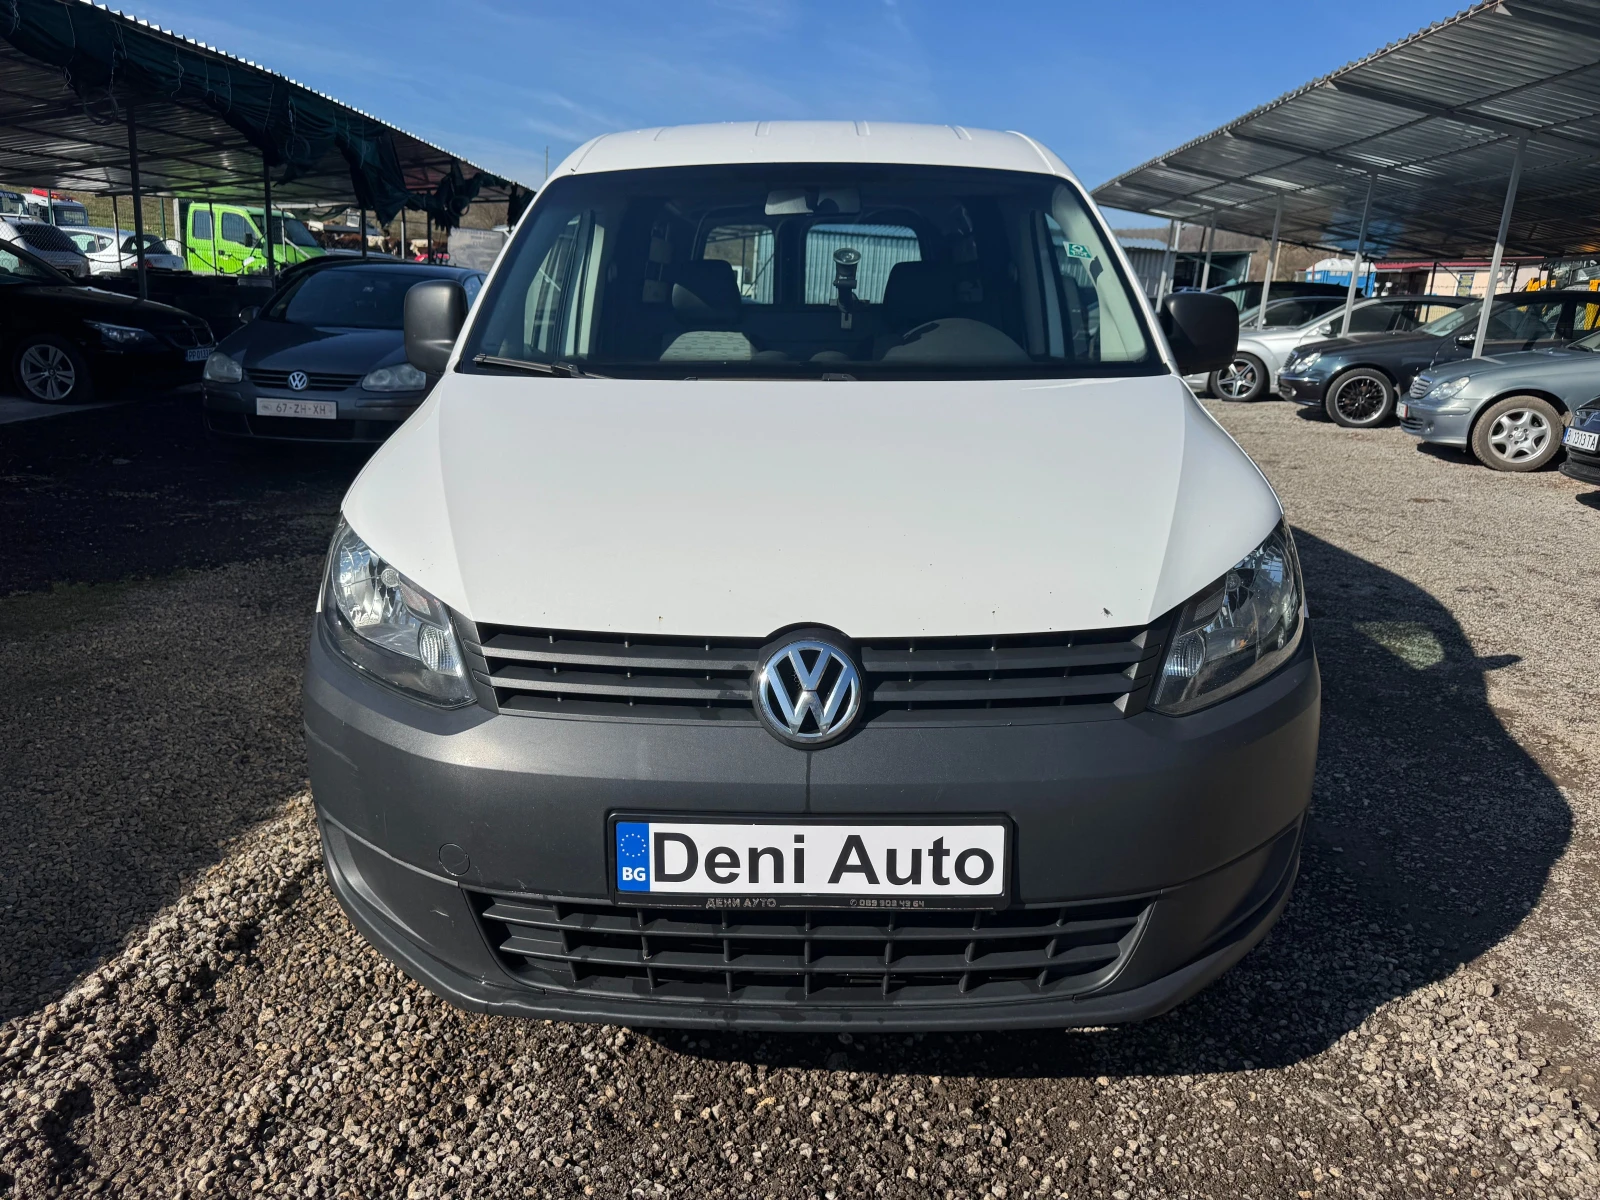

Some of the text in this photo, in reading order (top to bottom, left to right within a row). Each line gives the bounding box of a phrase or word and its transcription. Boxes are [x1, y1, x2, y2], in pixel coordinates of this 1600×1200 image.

[653, 832, 995, 886] Deni Auto
[622, 866, 646, 882] BG
[705, 897, 777, 909] ДЕНИ АУТО
